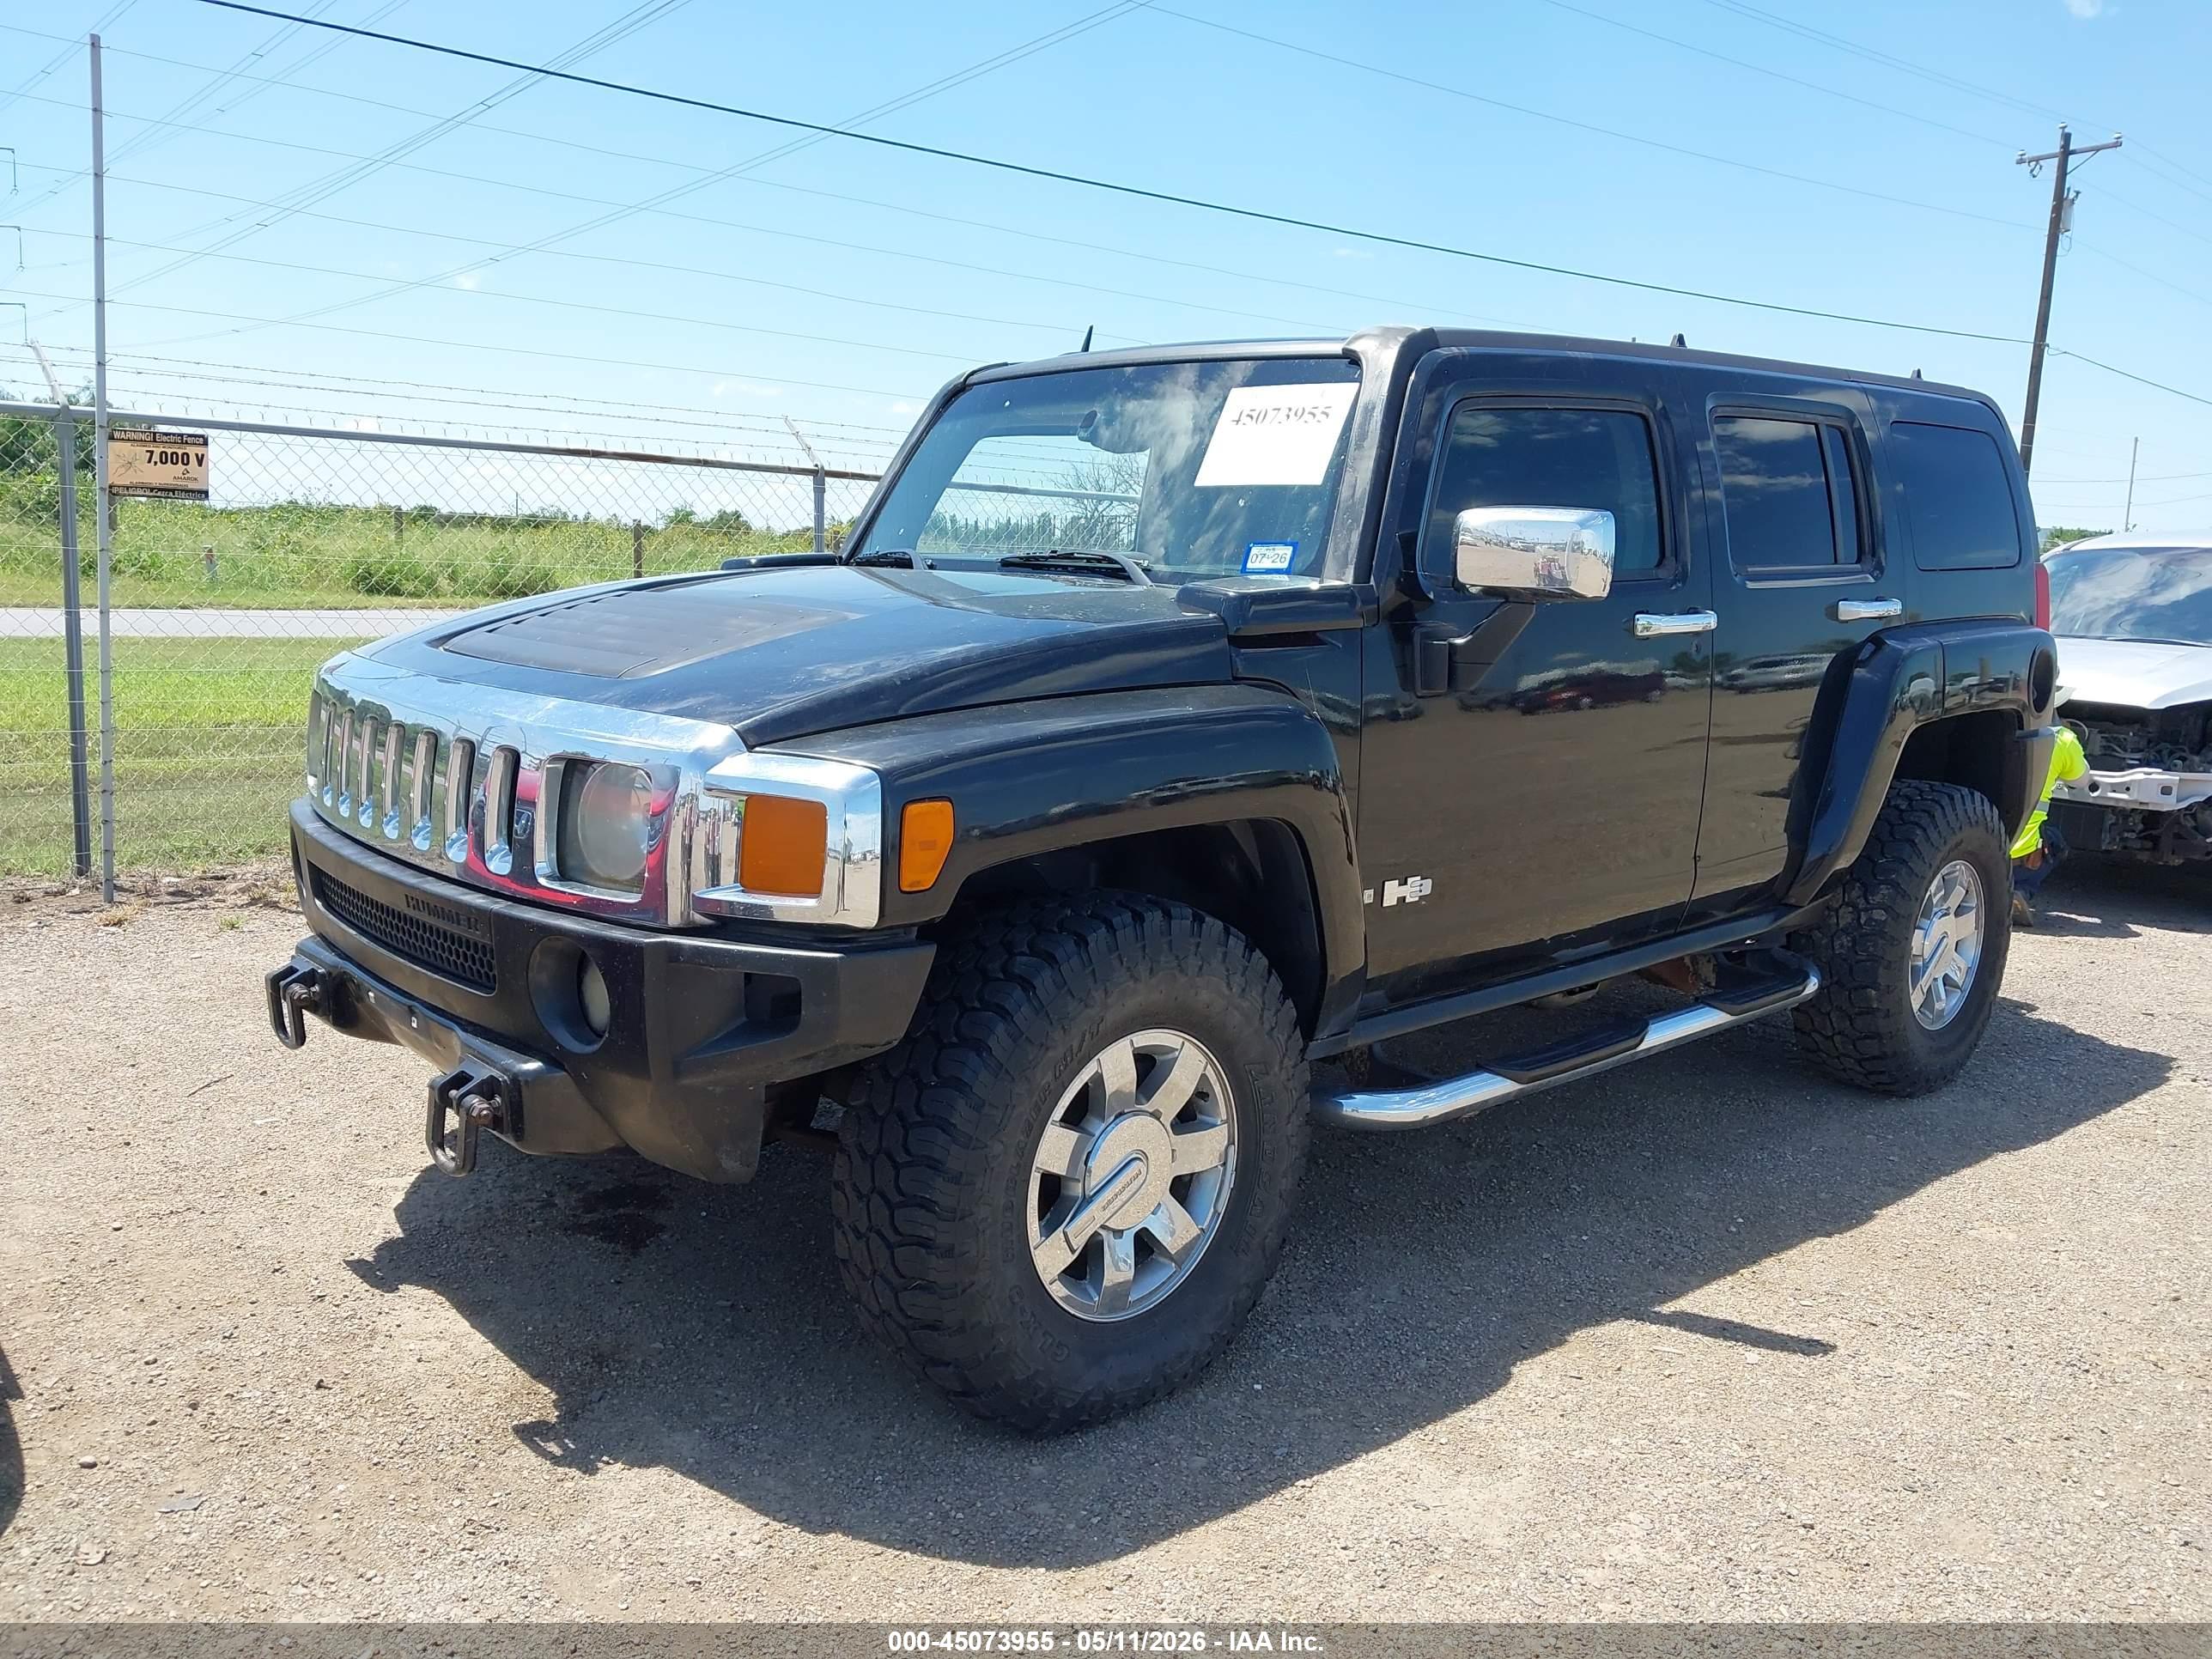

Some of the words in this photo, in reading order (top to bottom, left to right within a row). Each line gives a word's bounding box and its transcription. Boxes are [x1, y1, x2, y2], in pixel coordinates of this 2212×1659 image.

[1231, 406, 1332, 425] 45073955
[112, 430, 154, 441] WARNING!
[155, 433, 181, 443] Electric
[183, 434, 204, 445] Fence
[145, 449, 191, 466] 7,000
[195, 453, 205, 468] V
[1382, 876, 1432, 907] H3
[404, 893, 481, 934] HUMMER
